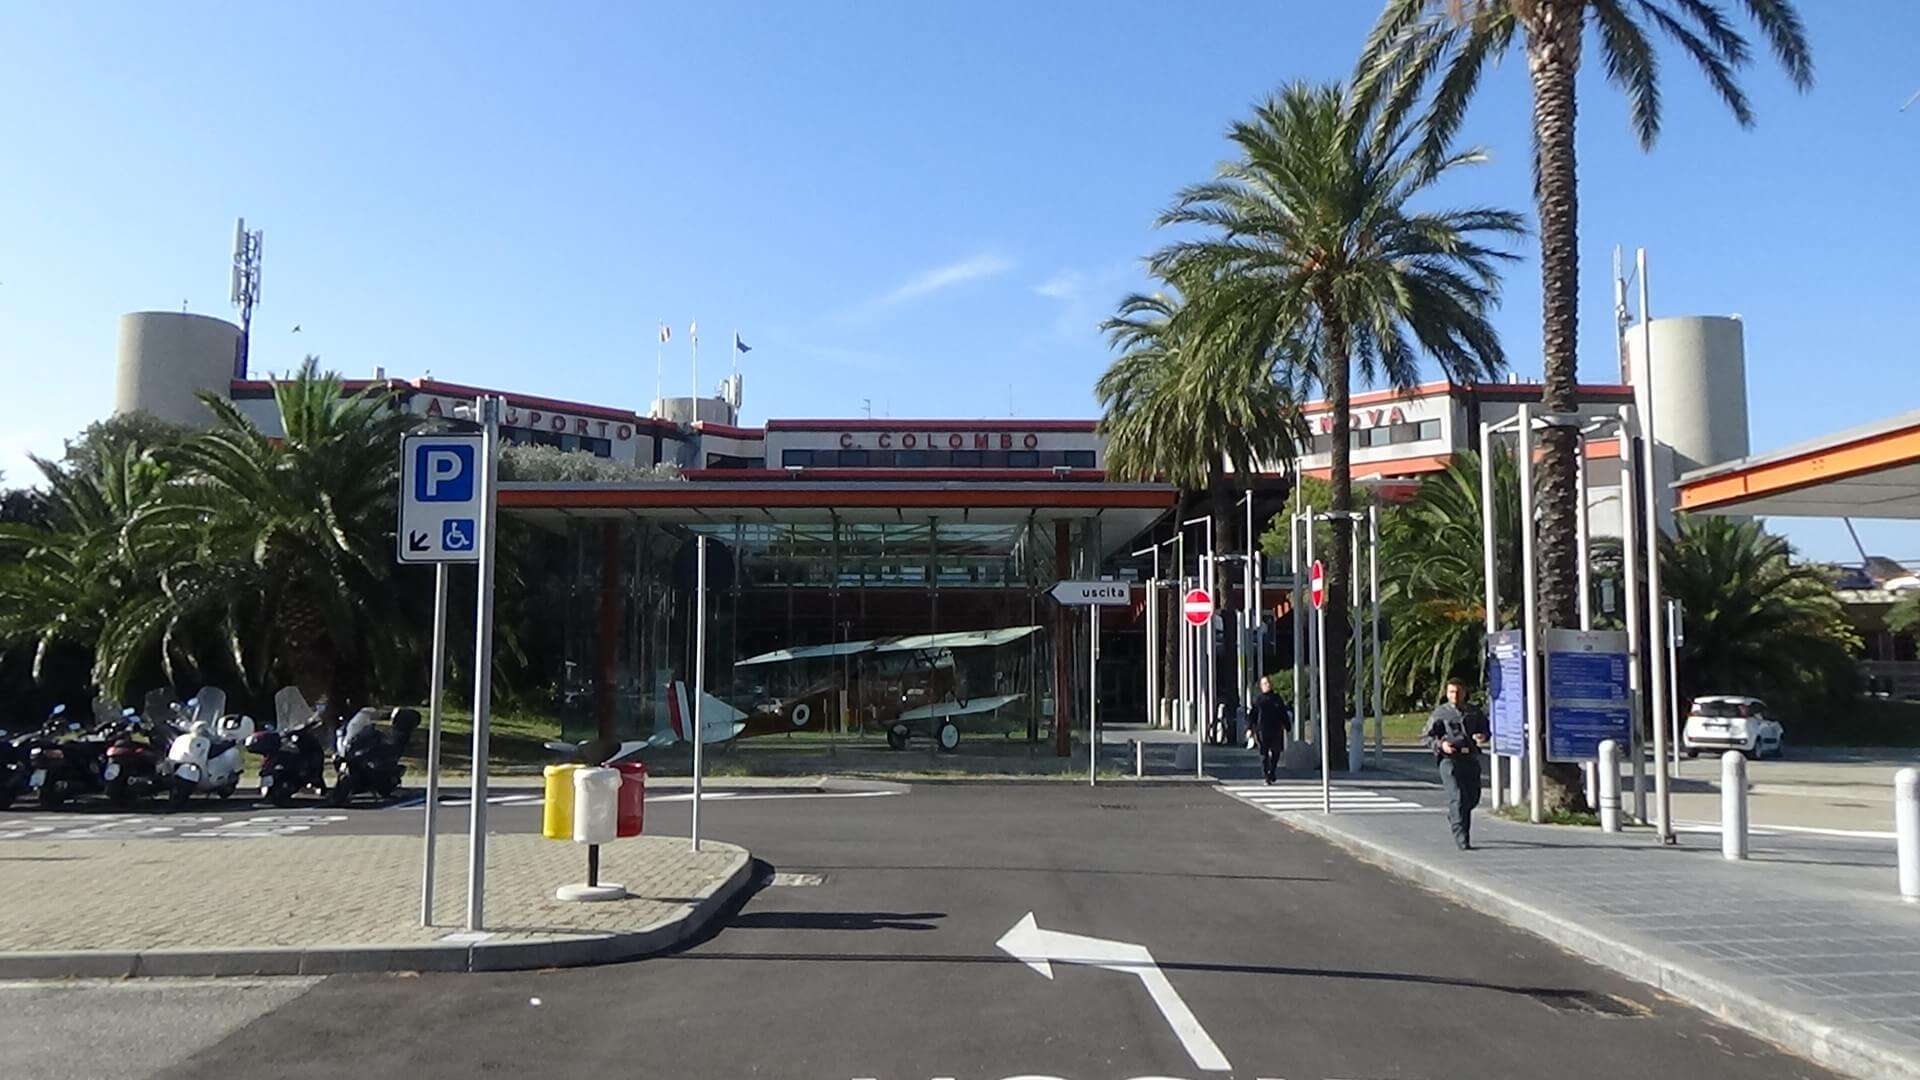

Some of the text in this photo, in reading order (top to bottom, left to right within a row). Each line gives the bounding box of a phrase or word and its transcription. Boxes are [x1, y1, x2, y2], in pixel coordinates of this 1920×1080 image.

[840, 433, 1038, 449] C. COLOMBO
[426, 450, 462, 496] P
[1082, 587, 1124, 598] uscita
